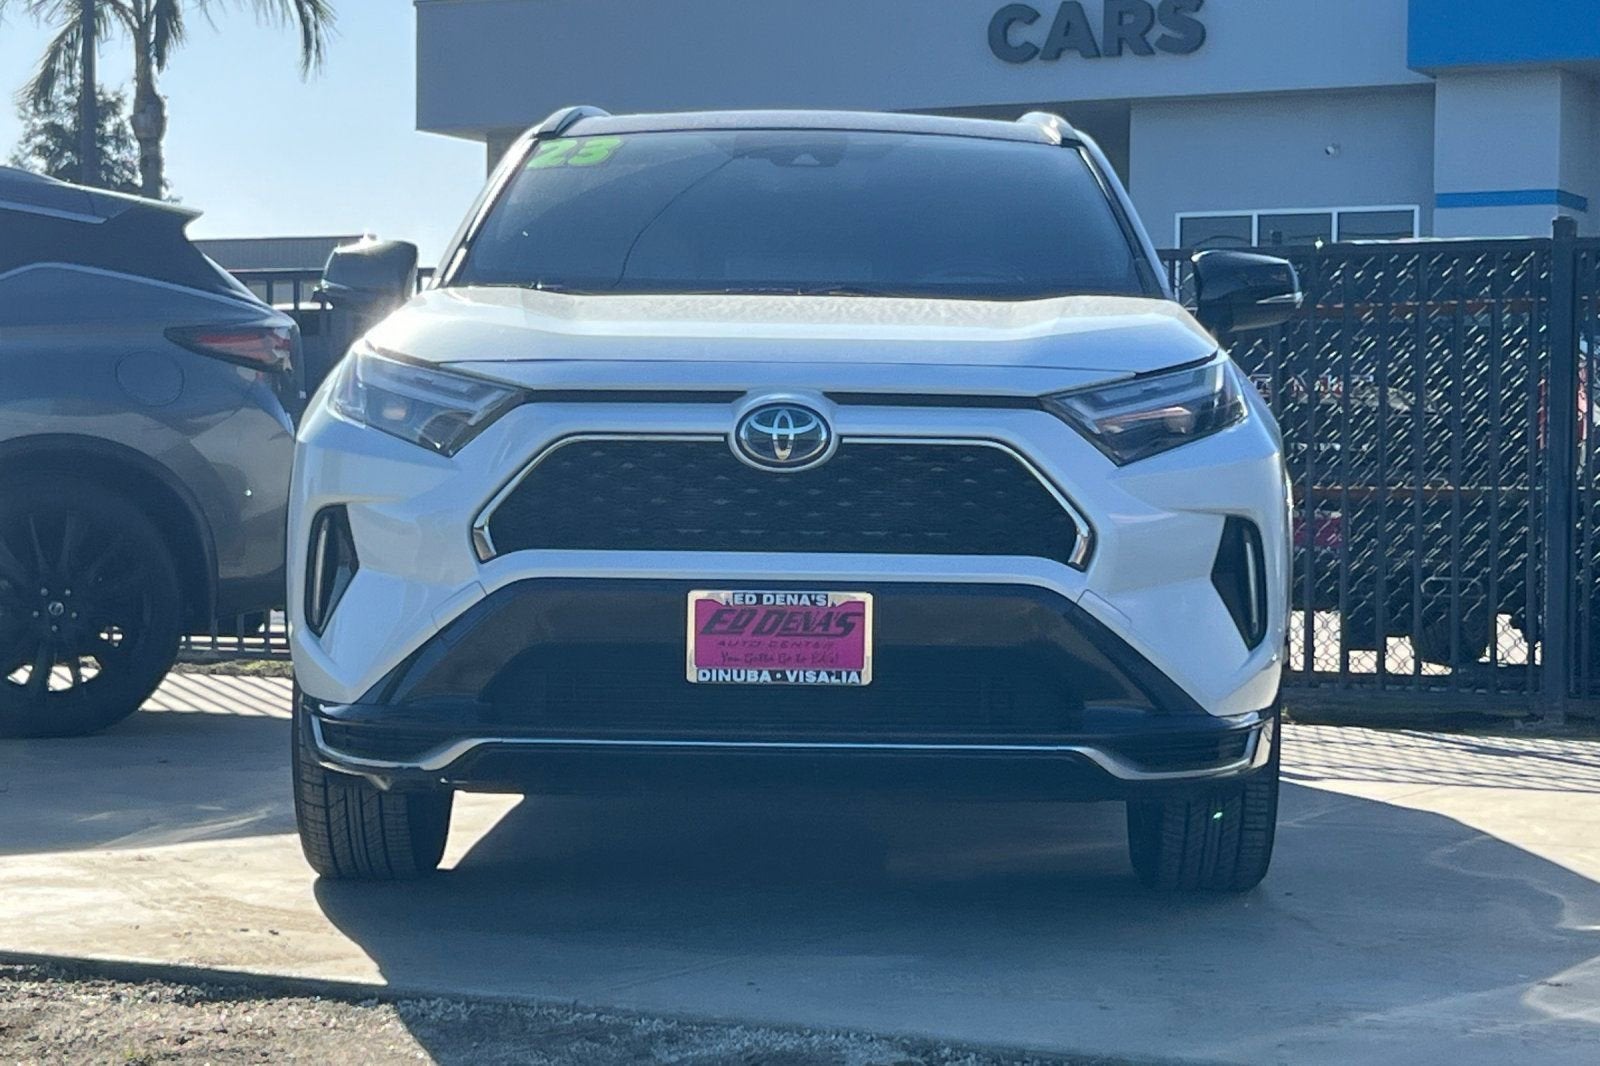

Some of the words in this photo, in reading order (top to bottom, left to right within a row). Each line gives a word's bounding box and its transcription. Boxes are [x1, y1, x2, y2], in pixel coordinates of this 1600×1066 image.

[988, 0, 1206, 63] CARS
[527, 137, 621, 169] 23
[734, 593, 757, 605] ED
[763, 593, 827, 607] DENA'S
[701, 608, 758, 635] ED
[699, 670, 772, 682] DINUBA
[785, 670, 861, 683] VISALIA
